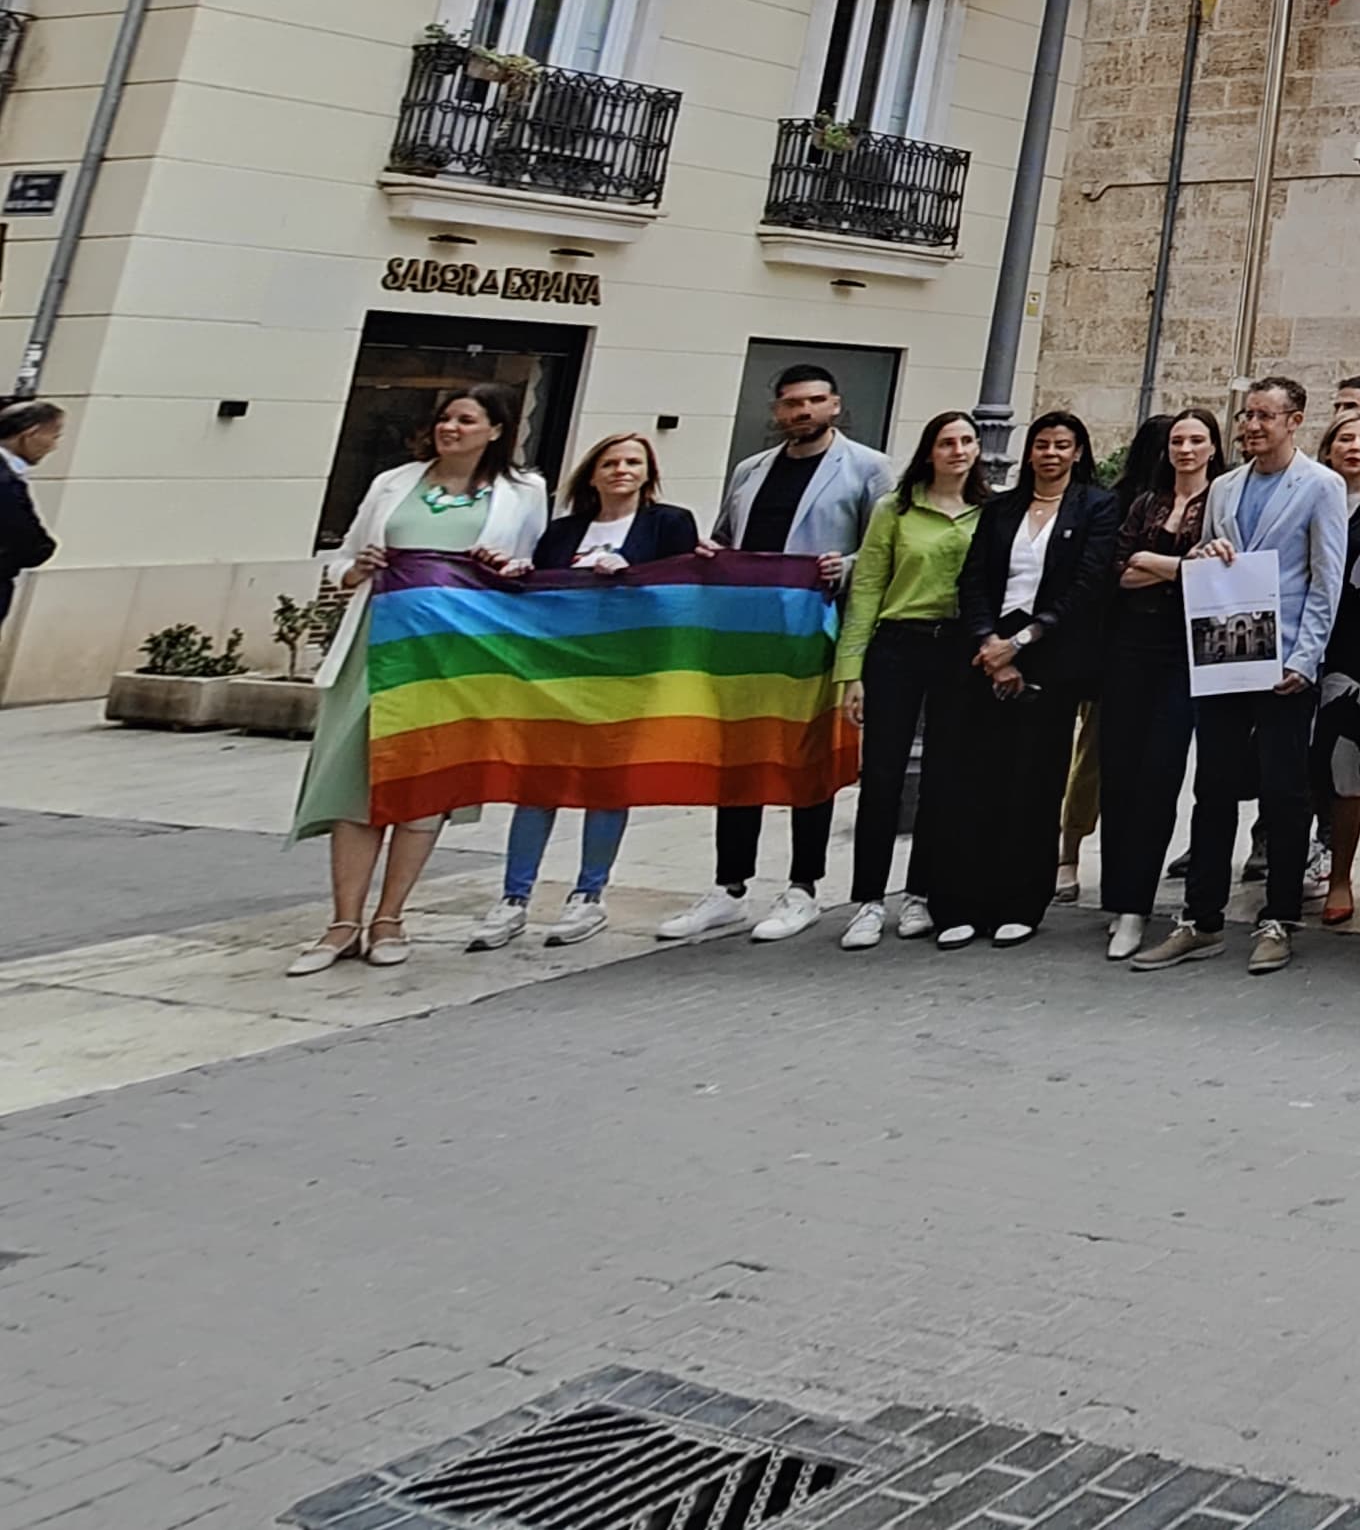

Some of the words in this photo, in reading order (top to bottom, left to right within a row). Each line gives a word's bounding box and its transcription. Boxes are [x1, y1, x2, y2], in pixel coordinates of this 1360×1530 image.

[382, 257, 479, 296] SABOR
[478, 269, 499, 295] A
[500, 267, 601, 306] ESPAÑA
